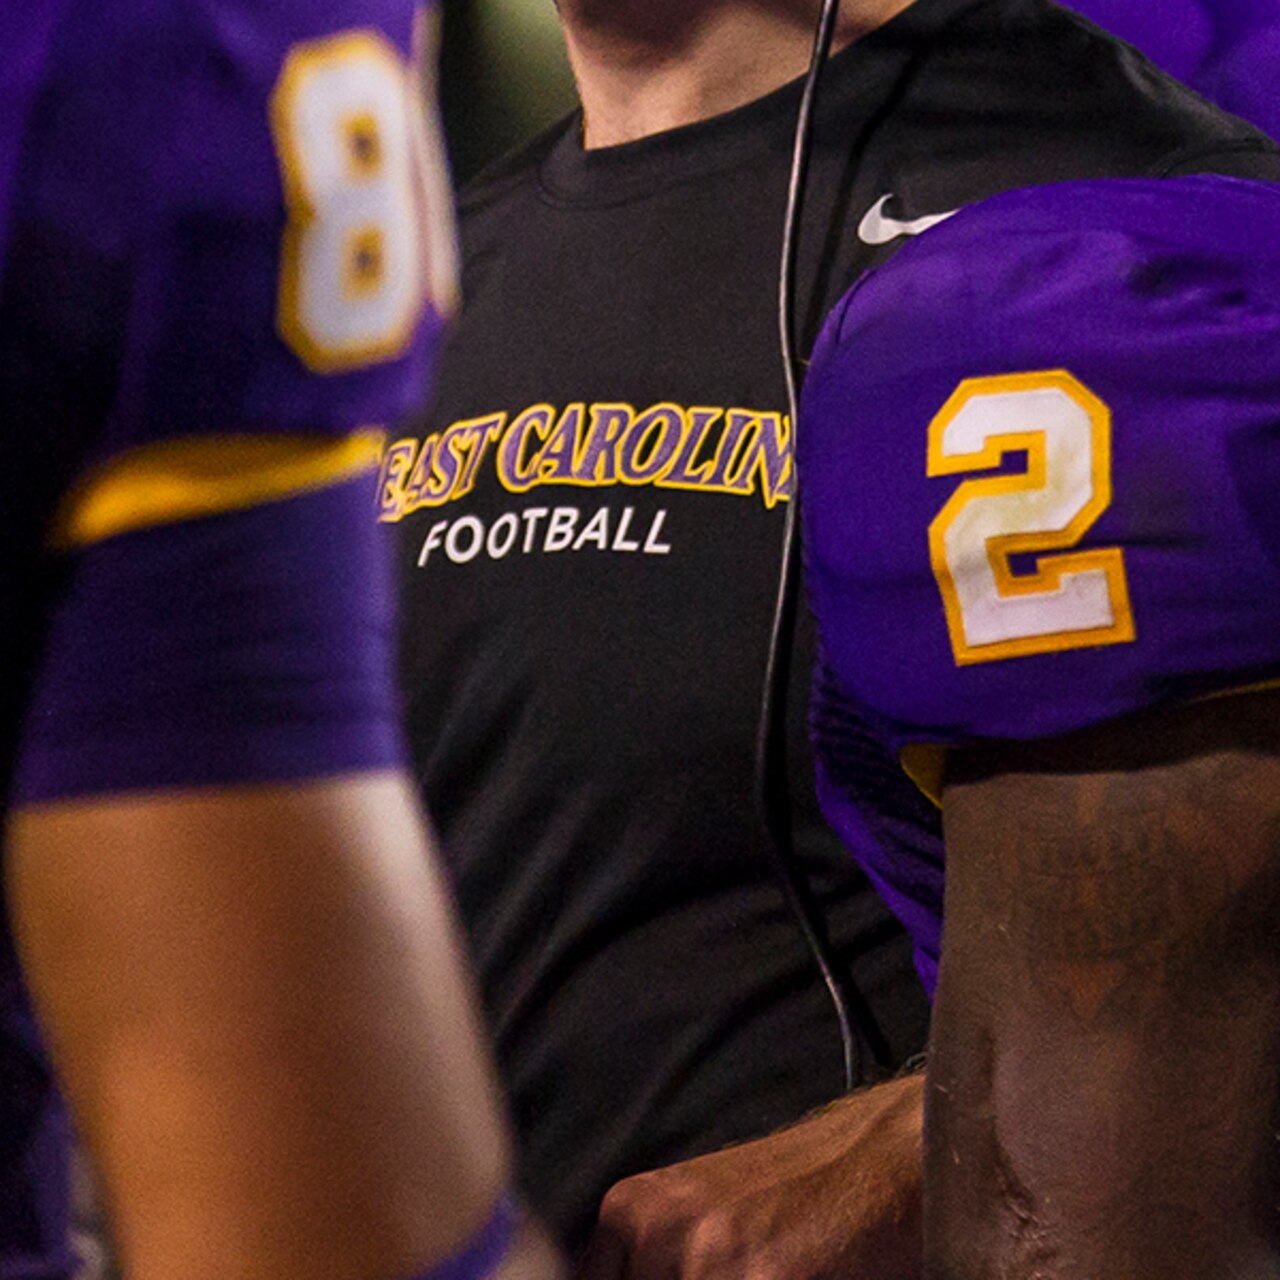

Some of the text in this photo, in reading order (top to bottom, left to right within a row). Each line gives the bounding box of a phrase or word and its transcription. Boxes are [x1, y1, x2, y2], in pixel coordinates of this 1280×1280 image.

[376, 402, 791, 523] EAST CAROLIN
[927, 368, 1136, 666] 2
[418, 506, 672, 568] FOOTBALL
